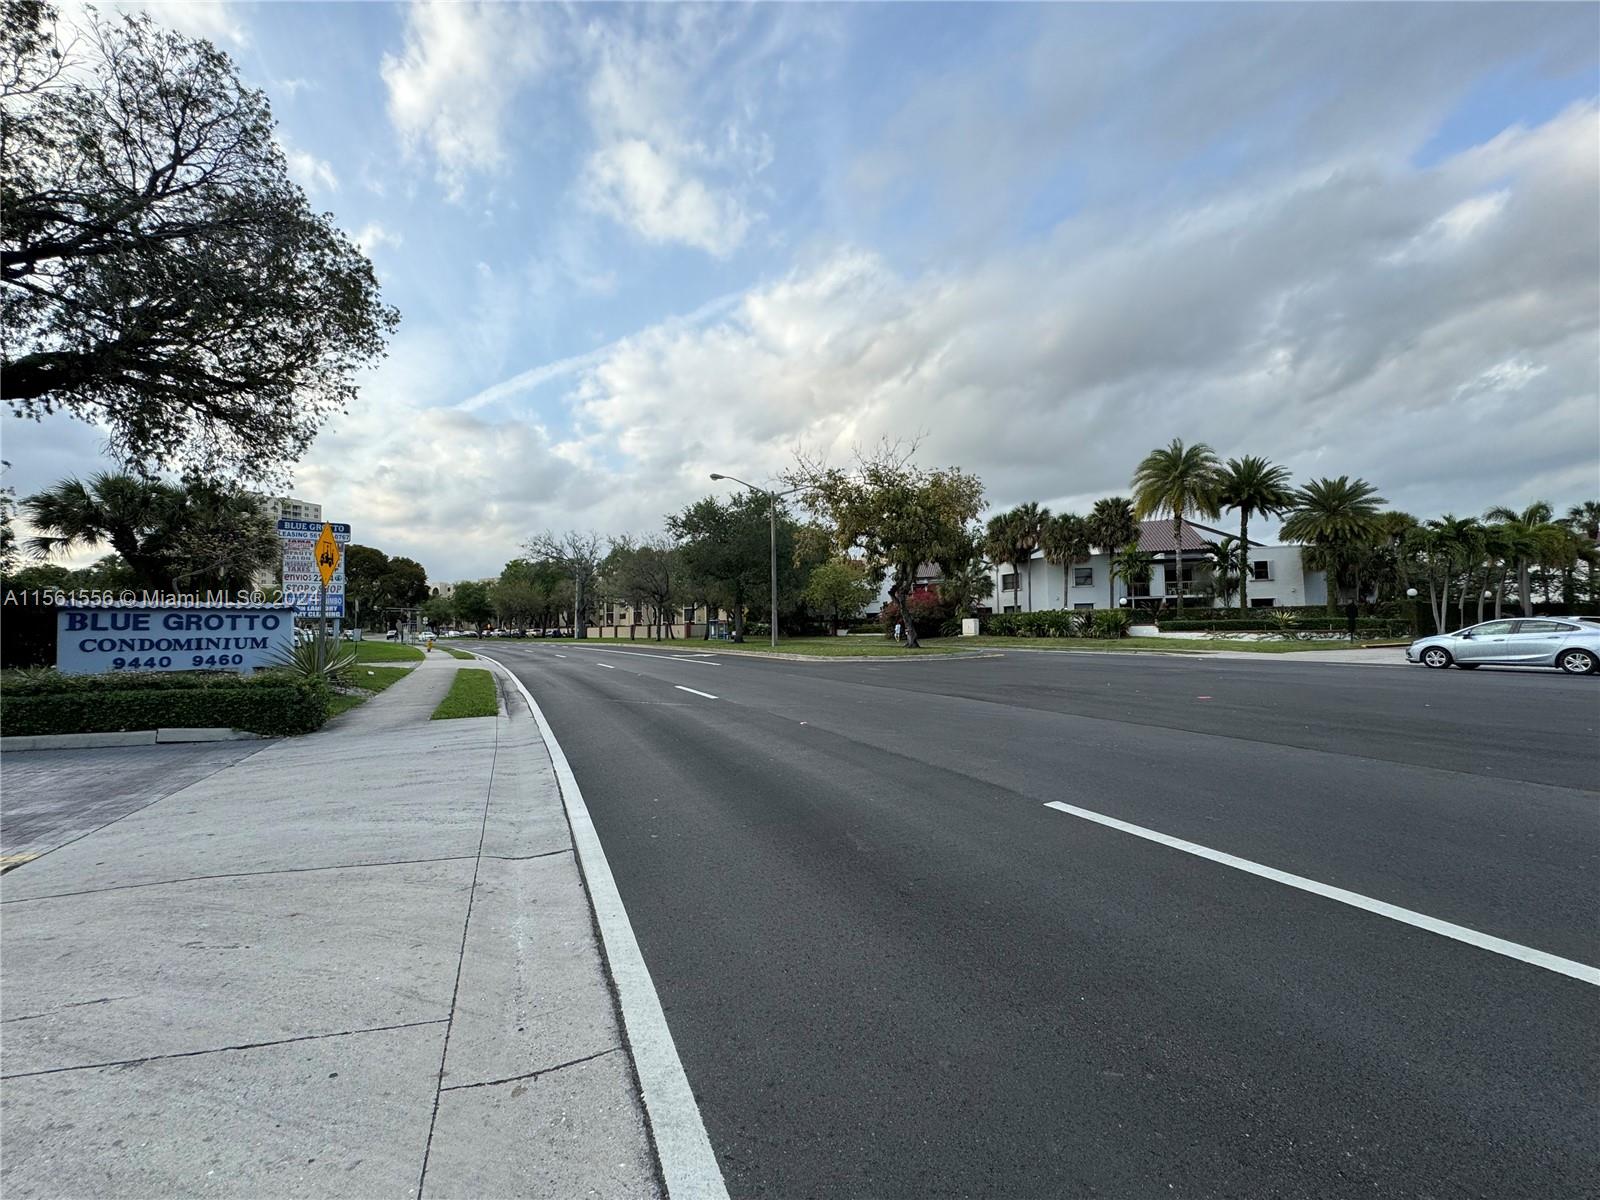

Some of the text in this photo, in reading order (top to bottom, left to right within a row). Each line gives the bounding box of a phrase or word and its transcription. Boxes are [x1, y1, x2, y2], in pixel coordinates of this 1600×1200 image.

[284, 522, 308, 530] BLUE
[283, 573, 312, 581] envios
[285, 584, 310, 592] STOP
[65, 612, 280, 631] BLUE GROTTO
[79, 637, 269, 653] CONDOMINIUM
[112, 654, 243, 670] 9440 9460
